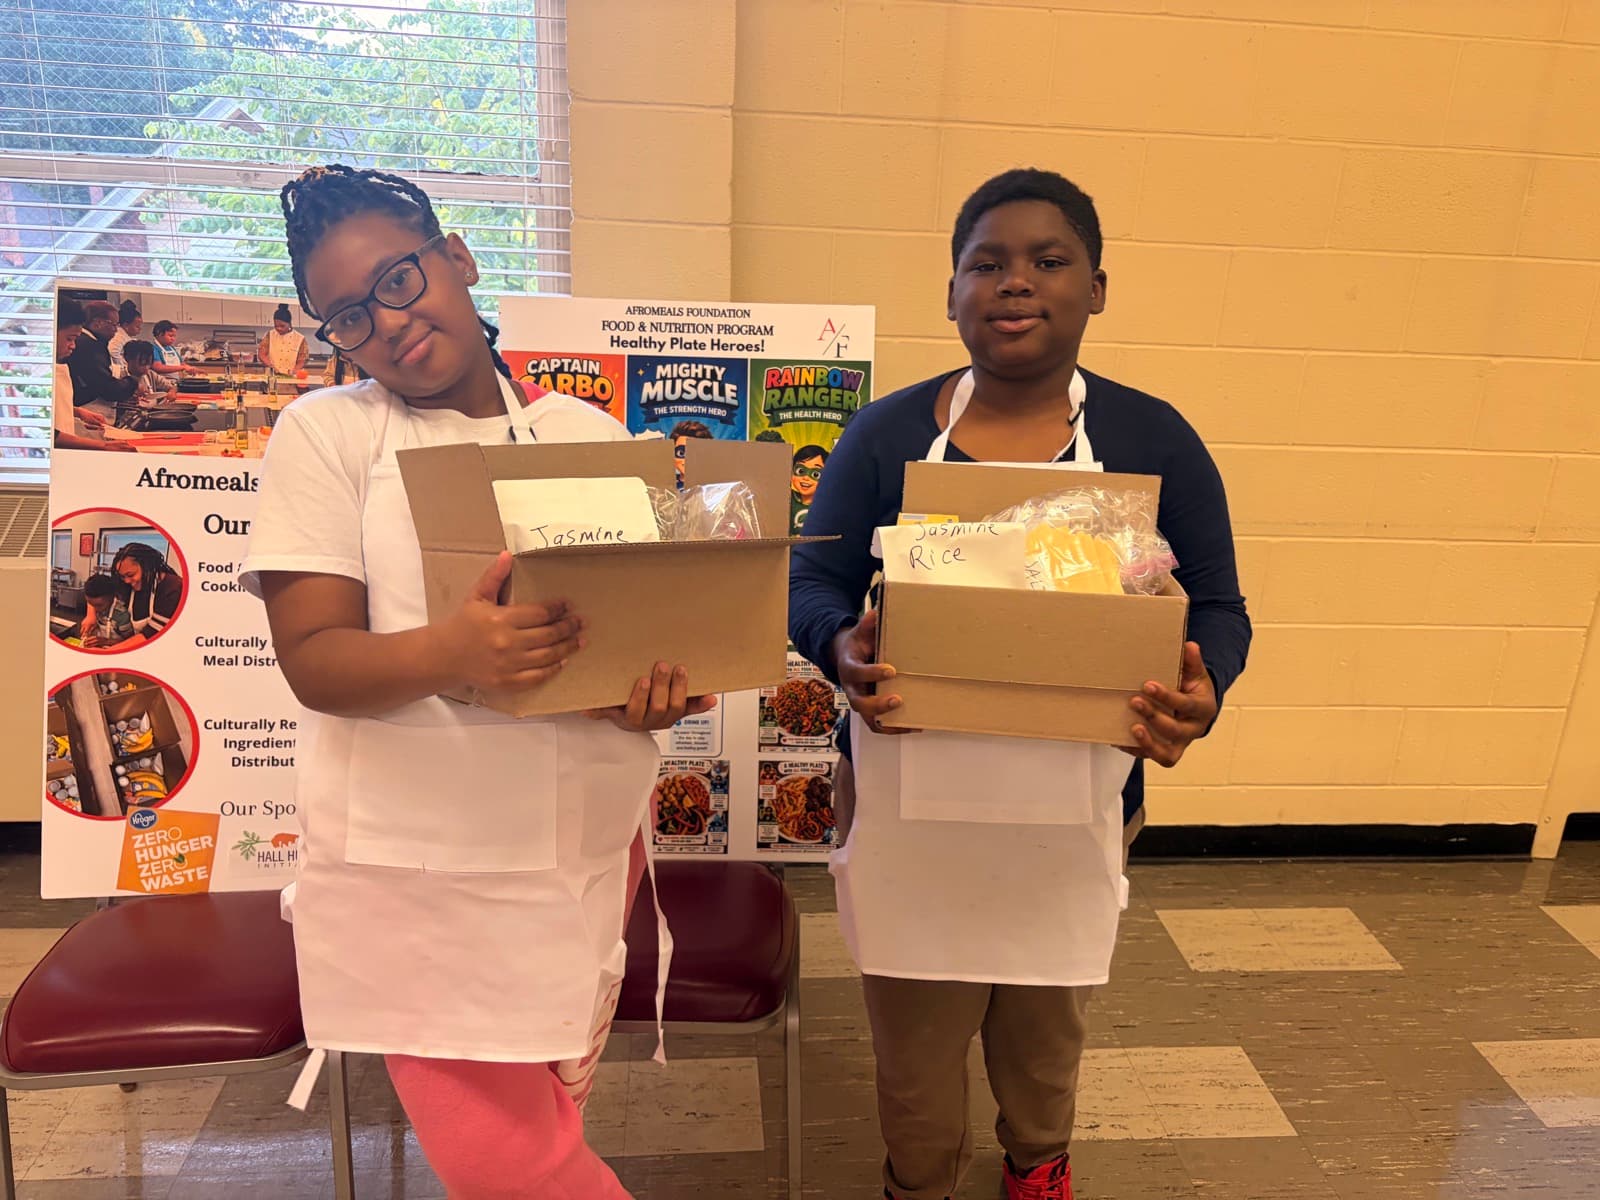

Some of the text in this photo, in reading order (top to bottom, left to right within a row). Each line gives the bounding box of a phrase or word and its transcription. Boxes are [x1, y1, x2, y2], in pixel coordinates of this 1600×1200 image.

[624, 306, 751, 319] AFROMEALS FOUNDATION
[601, 319, 775, 336] FOOD & NUTRITION PROGRAM
[609, 335, 766, 352] Healthy Plate Heroes!
[527, 358, 600, 375] CAPTAIN
[655, 363, 726, 381] MIGHTY
[766, 366, 863, 391] RAINBOW
[640, 379, 739, 406] MUSCLE
[764, 387, 858, 411] RANGER
[654, 405, 727, 417] THE STRENGTH HERO
[779, 410, 842, 421] THE HEALTH HERO
[136, 467, 259, 492] Afromeals
[203, 513, 251, 535] Our
[914, 522, 999, 541] Jasmine
[530, 525, 628, 549] Jasmine
[909, 545, 967, 570] Rice
[198, 562, 233, 573] Food
[195, 636, 268, 651] Culturally
[203, 655, 278, 667] Meal Distr
[203, 719, 276, 733] Culturally
[231, 756, 295, 768] Distribut
[220, 801, 257, 817] Our
[131, 811, 158, 828] Kroger
[131, 826, 183, 849] ZERO
[134, 834, 214, 864] HUNGER
[257, 849, 285, 863] HALL
[137, 855, 188, 879] ZERO
[140, 865, 209, 892] WASTE
